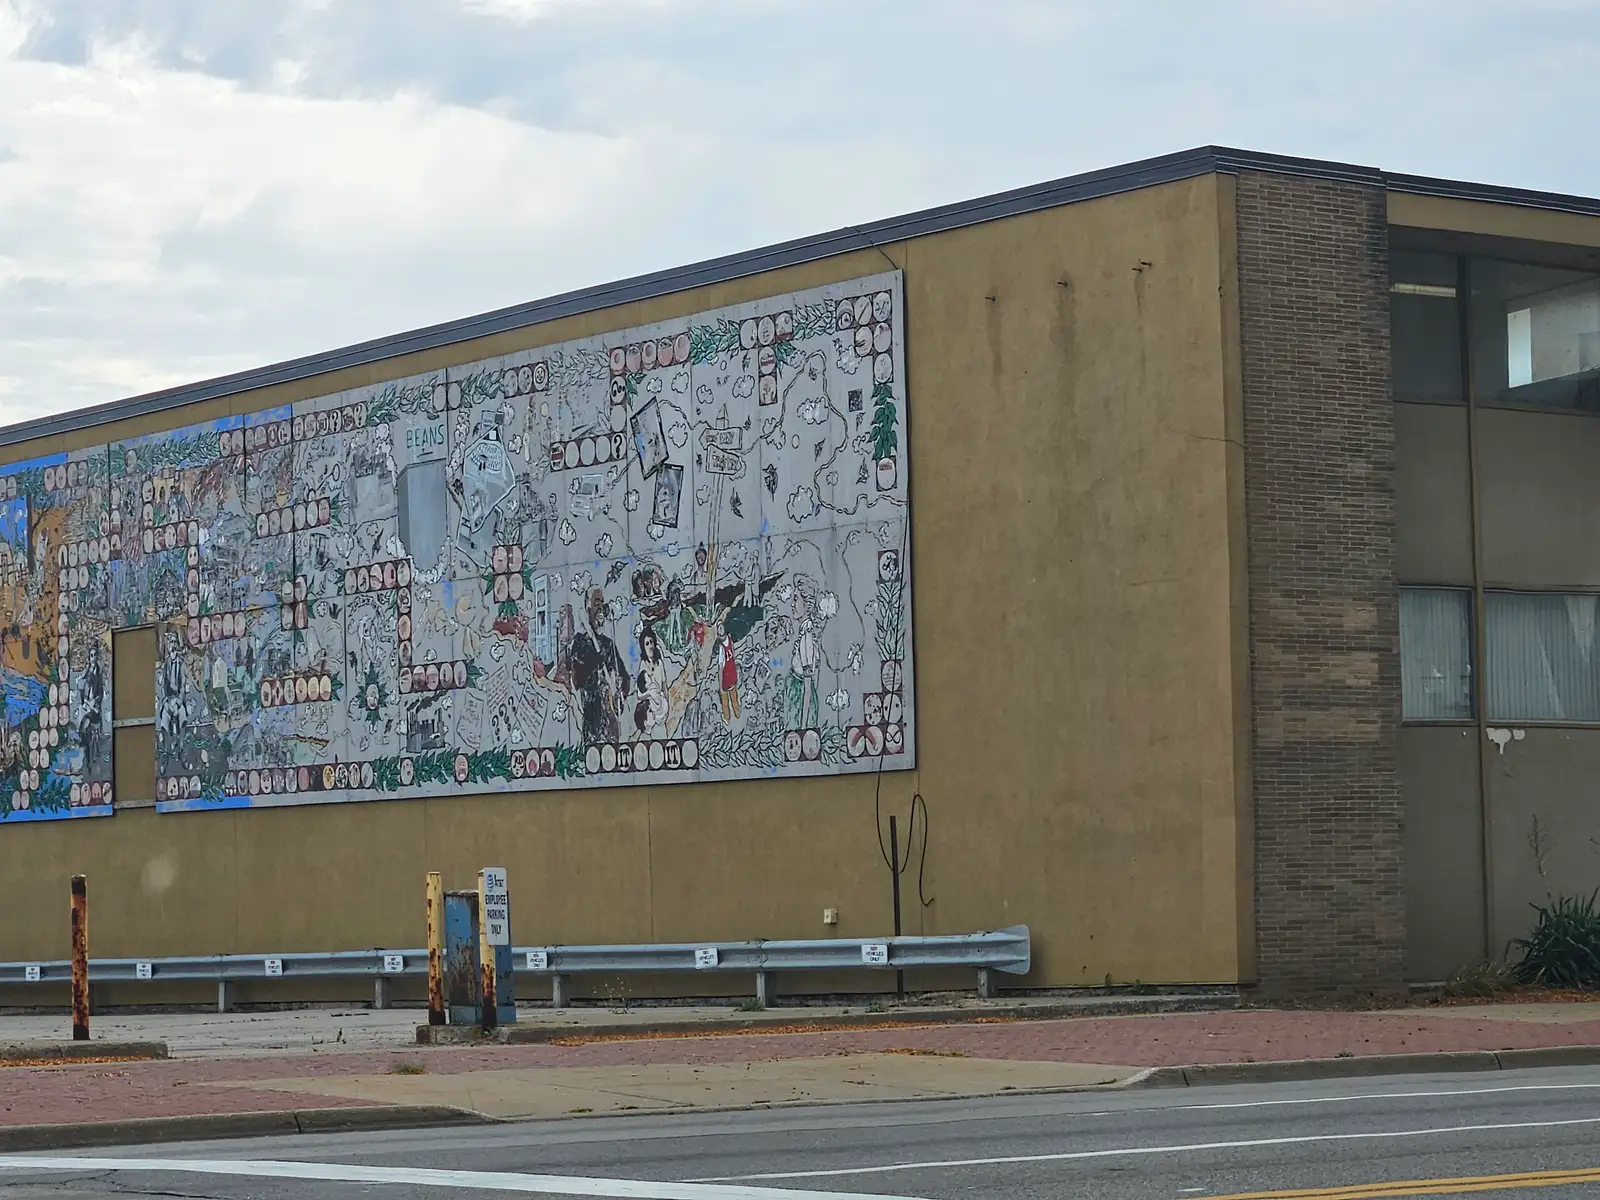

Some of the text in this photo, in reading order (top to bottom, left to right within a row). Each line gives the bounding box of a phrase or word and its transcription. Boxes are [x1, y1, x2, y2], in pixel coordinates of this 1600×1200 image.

[406, 424, 445, 449] BEANS
[485, 894, 507, 905] EMPLOYEE
[487, 909, 506, 920] PARKING
[491, 924, 502, 935] ONLY
